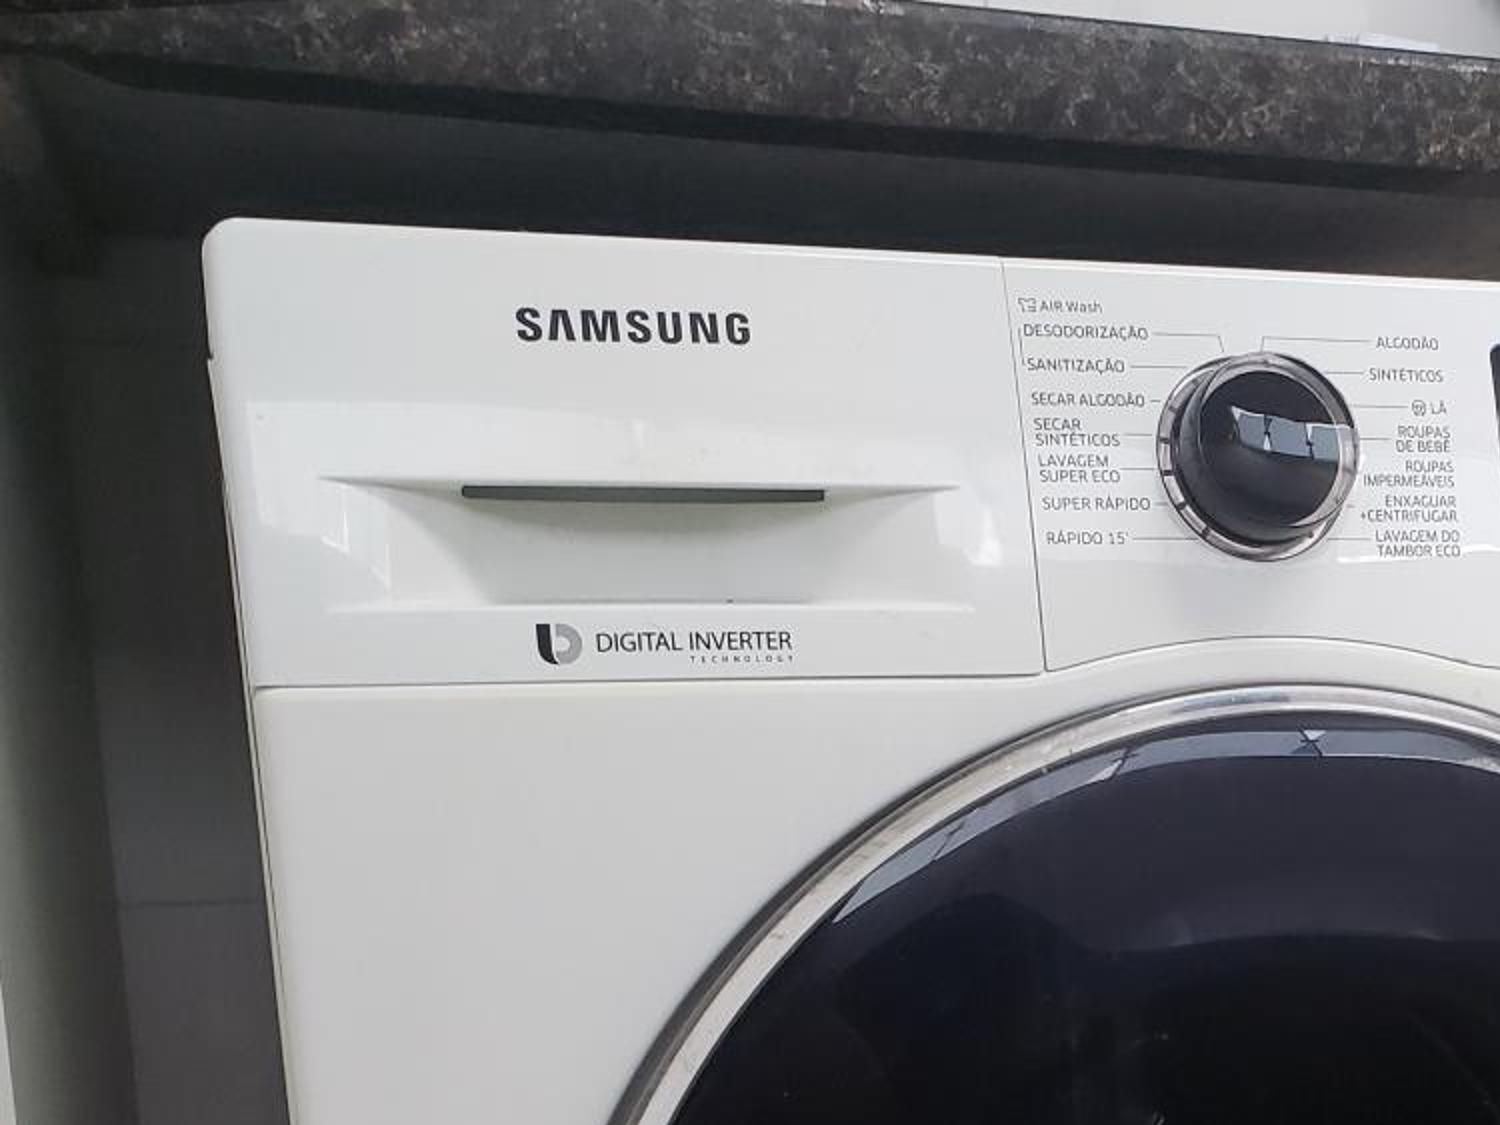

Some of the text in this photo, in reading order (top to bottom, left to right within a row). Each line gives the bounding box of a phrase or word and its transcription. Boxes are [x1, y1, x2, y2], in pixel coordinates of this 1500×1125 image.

[1040, 299, 1103, 314] AIR Wash
[515, 306, 751, 345] SAMSUNG
[1023, 323, 1149, 341] DESODORIZAÇÃO
[1376, 335, 1439, 350] ALGODÃO
[1027, 357, 1125, 375] SANITIZAÇÃO
[1369, 367, 1444, 382] SINTÉTICOS
[1031, 392, 1145, 407] SECAR ALGODÃO
[1033, 417, 1081, 431] SECAR
[1397, 424, 1451, 439] ROUPAS
[1035, 432, 1121, 447] SINTÉTICOS
[1396, 439, 1415, 453] DE
[1038, 454, 1109, 467] LAVAGEM
[1405, 459, 1455, 473] ROUPAS
[1039, 469, 1121, 483] SUPER ECO
[1363, 473, 1455, 488] IMPERMEÁVEIS
[1042, 495, 1151, 511] SUPER RÁPIDO
[1385, 495, 1457, 508] ENXAGUAR
[1045, 530, 1103, 545] RÁPIDO
[1375, 529, 1460, 542] LAVAGEM DO
[1376, 543, 1461, 557] TAMBOR ECO
[596, 631, 793, 653] DIGITAL INVERTER
[690, 655, 794, 664] TECHNOLOGY
